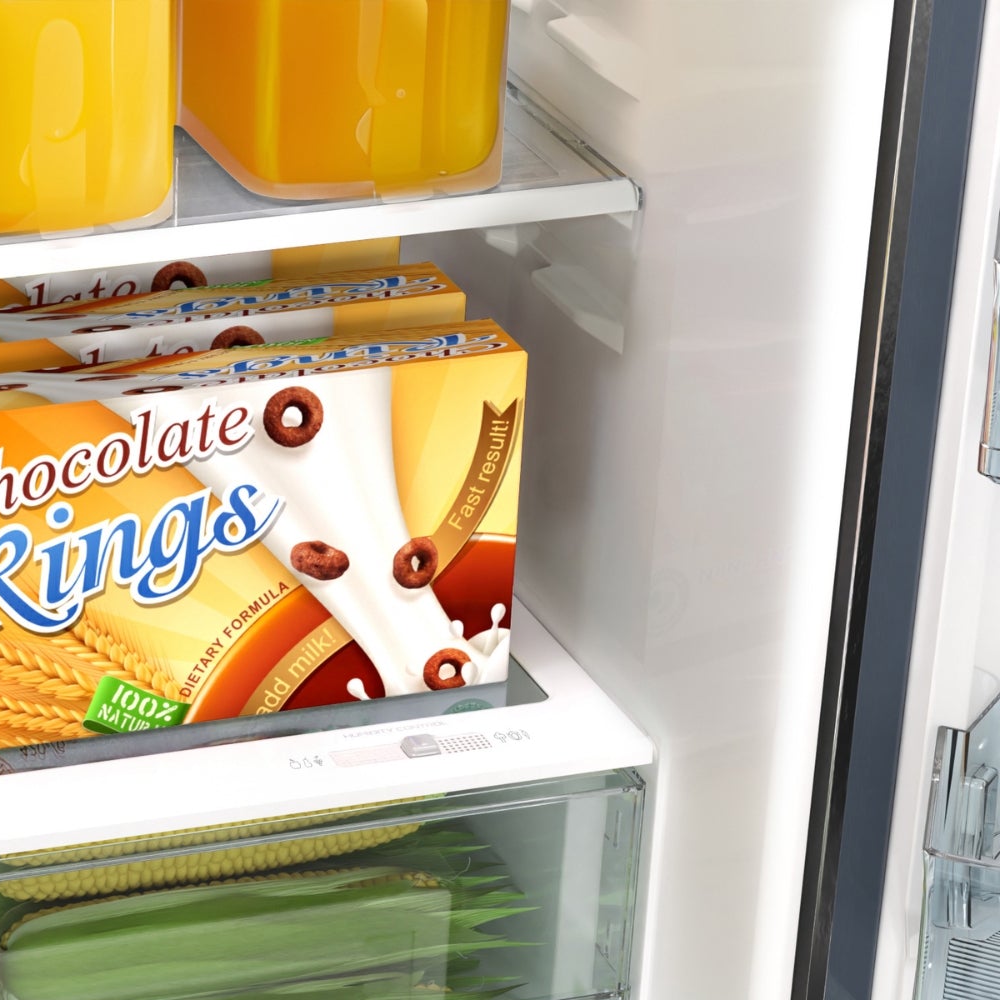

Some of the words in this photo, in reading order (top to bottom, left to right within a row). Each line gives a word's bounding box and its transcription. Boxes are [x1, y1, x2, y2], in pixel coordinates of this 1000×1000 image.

[448, 486, 485, 530] Fast
[478, 420, 510, 482] result!
[179, 638, 224, 698] DIETARY
[222, 581, 290, 639] FORMULA
[288, 627, 337, 678] milk!
[111, 684, 178, 721] 100%
